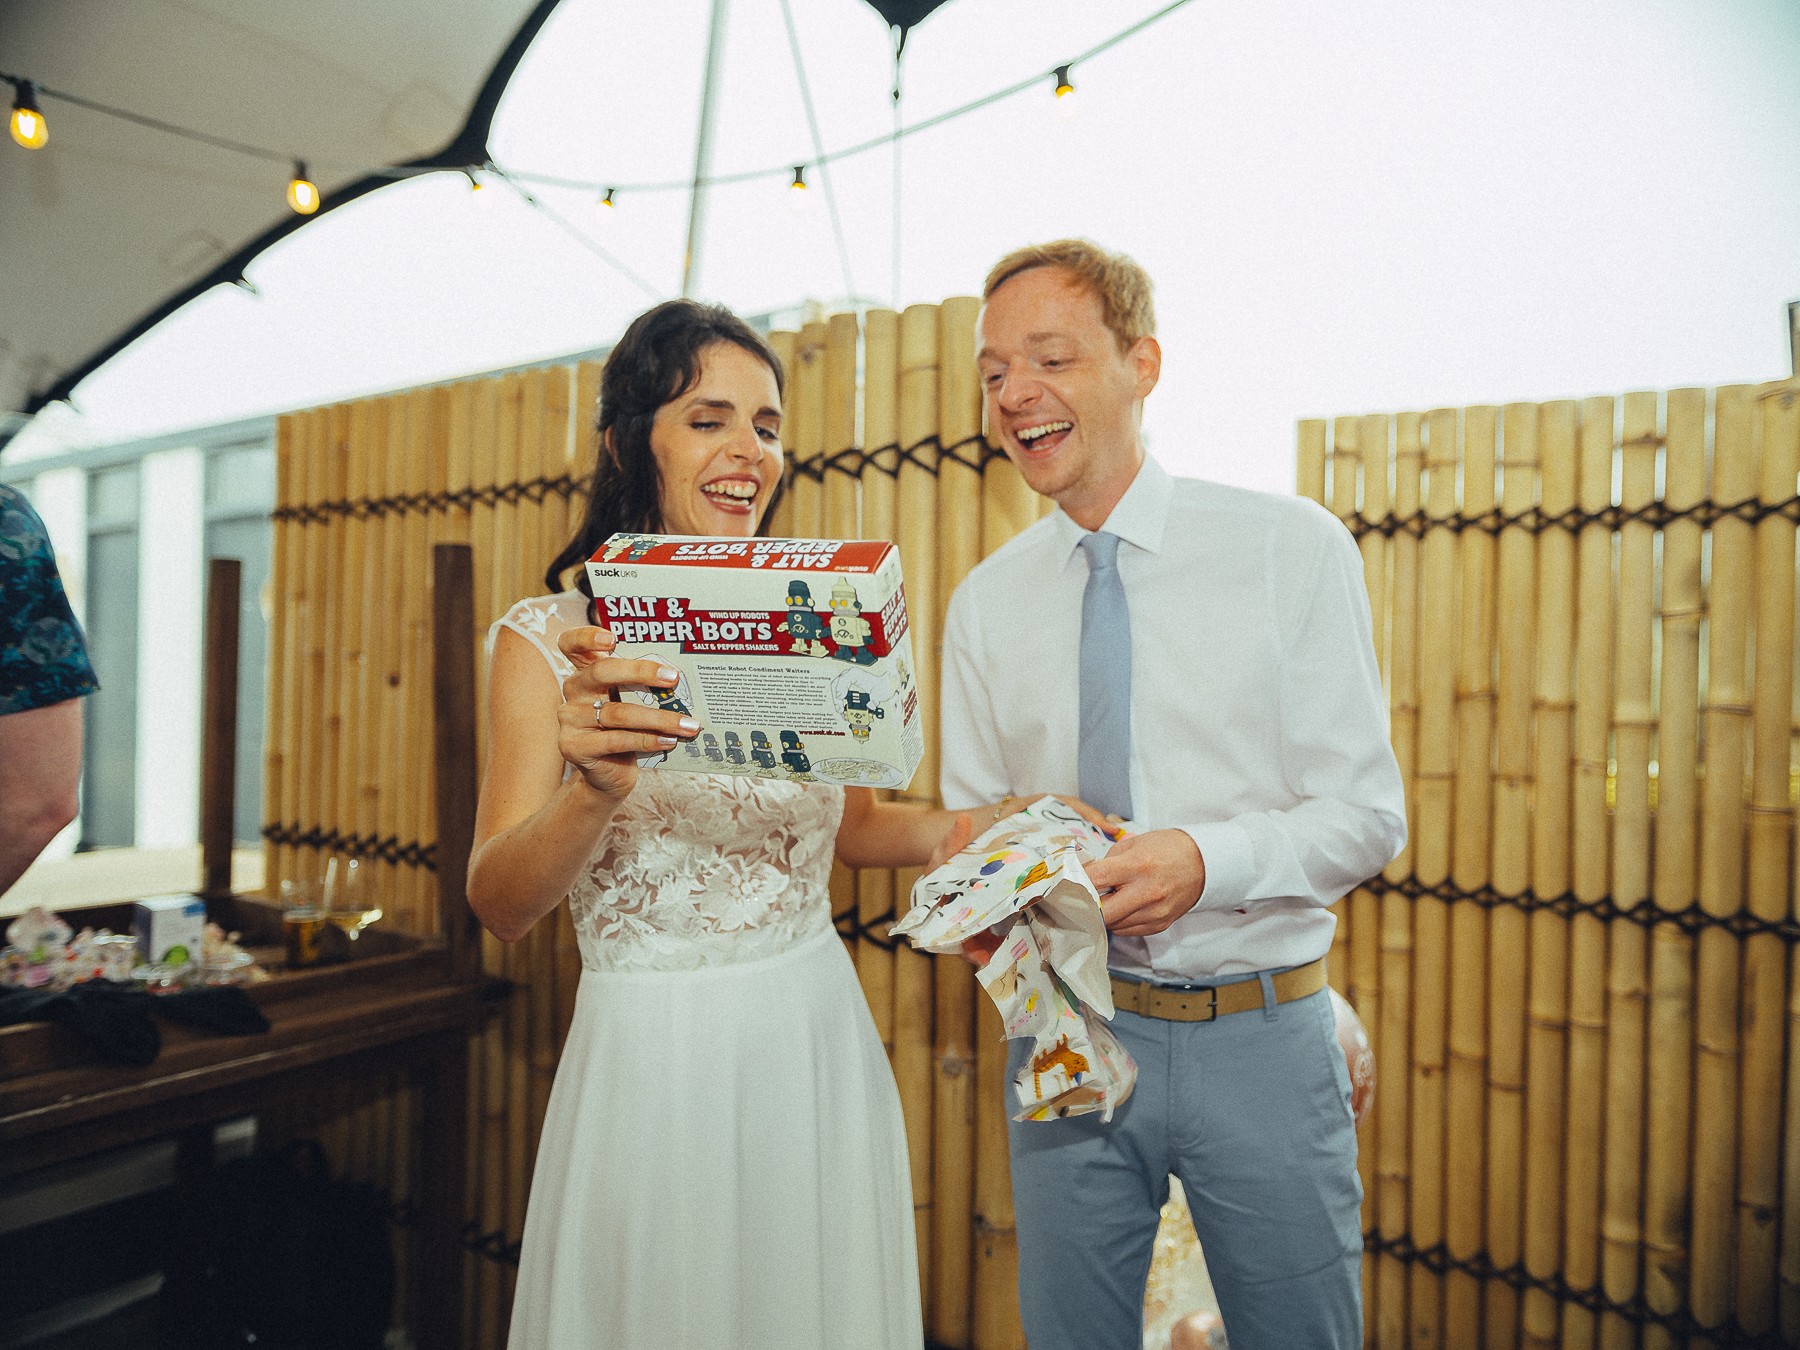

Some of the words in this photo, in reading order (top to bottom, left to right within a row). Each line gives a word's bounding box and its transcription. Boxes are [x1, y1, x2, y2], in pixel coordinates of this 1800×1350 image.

[752, 541, 844, 553] PEPPER
[751, 554, 770, 568] &
[771, 553, 834, 568] SALT
[604, 595, 658, 618] SALT
[666, 597, 685, 618] &
[740, 612, 770, 620] ROBOTS
[609, 621, 696, 643] PEPPER
[710, 643, 716, 651] &
[716, 643, 744, 651] PEPPER
